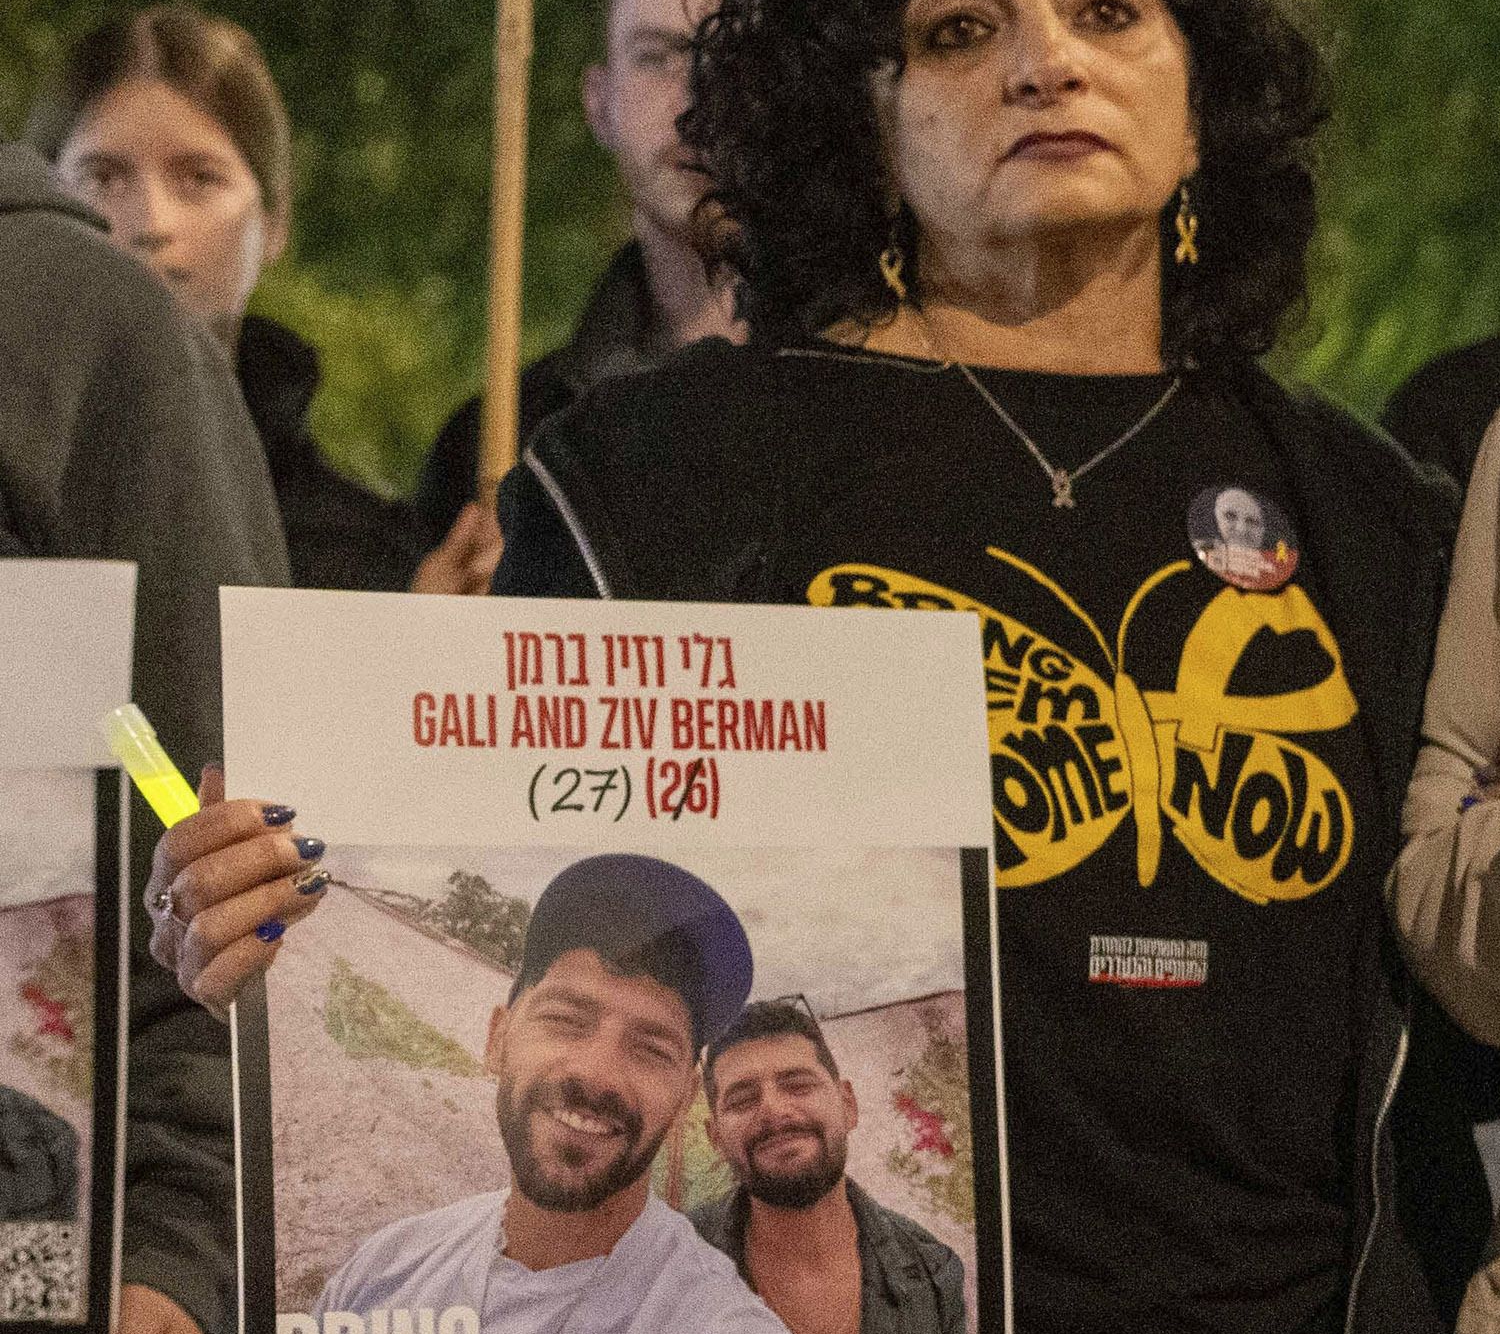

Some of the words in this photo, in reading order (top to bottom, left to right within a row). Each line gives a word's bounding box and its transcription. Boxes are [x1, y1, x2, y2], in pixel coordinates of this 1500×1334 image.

[504, 632, 589, 691] ברמן
[602, 635, 665, 687] וזיו
[678, 633, 736, 688] גלי
[414, 693, 497, 748] GALI
[511, 695, 587, 748] AND
[599, 697, 657, 750] ZIV
[671, 699, 826, 751] BERMAN
[528, 764, 632, 822] (27)
[646, 757, 720, 821] (26)
[991, 722, 1128, 845] OME
